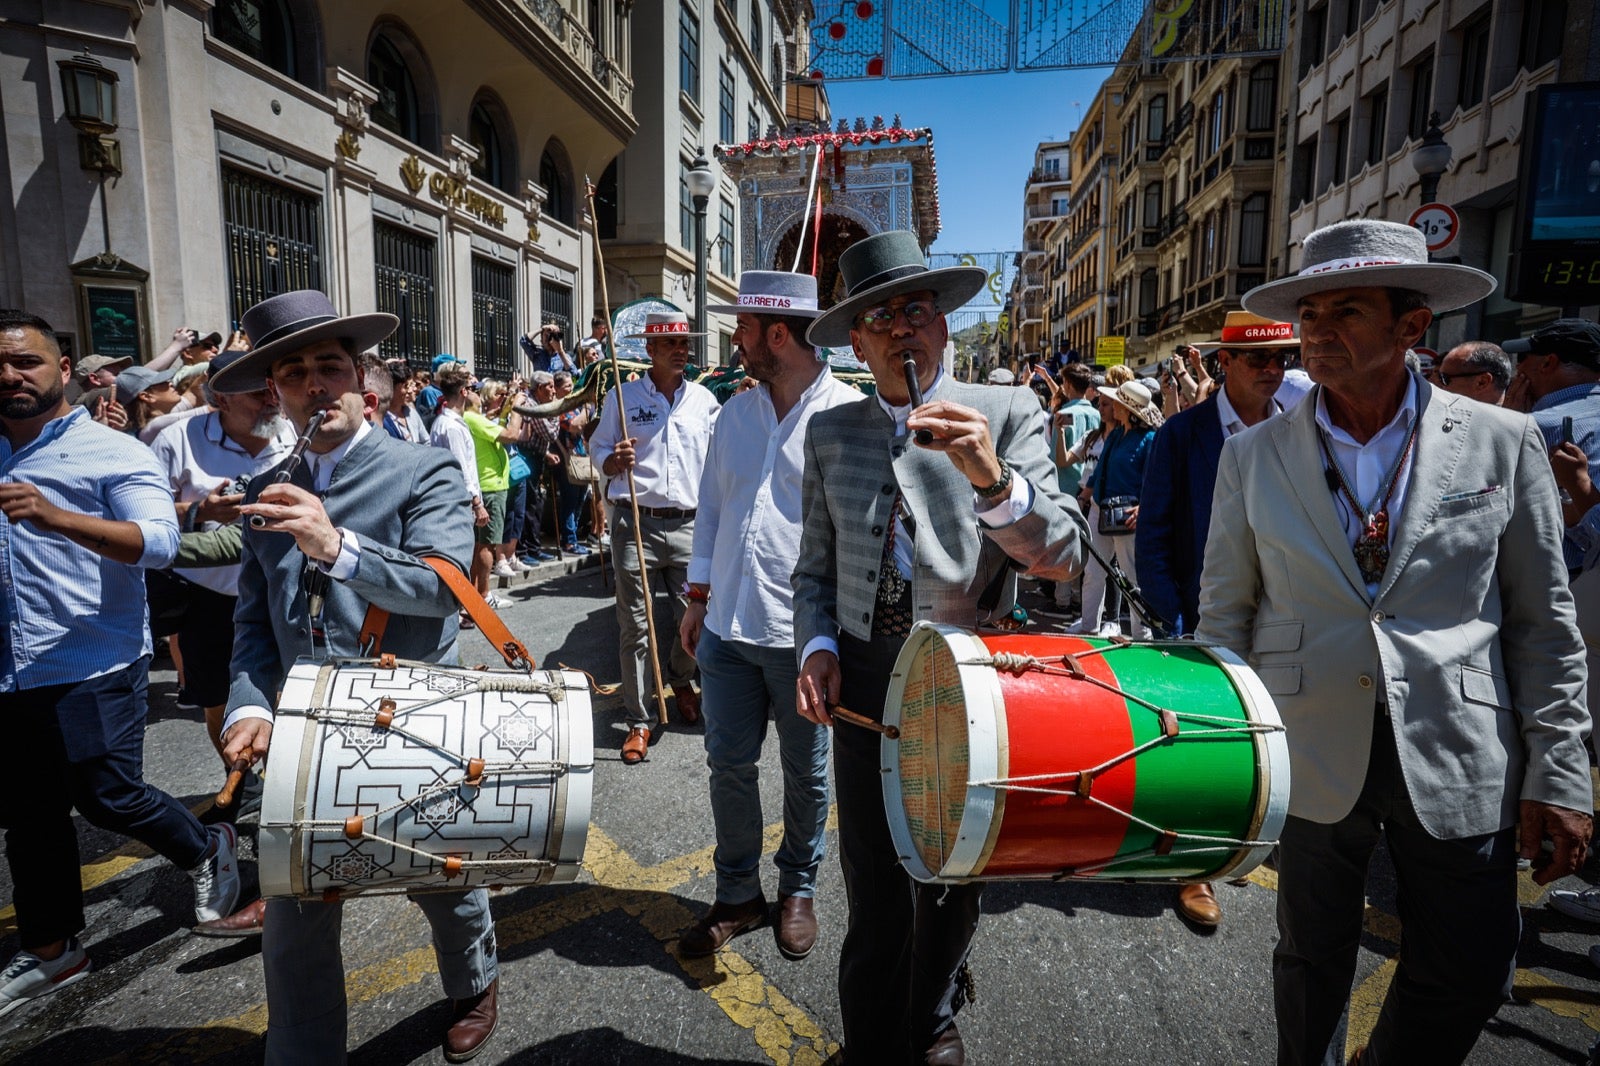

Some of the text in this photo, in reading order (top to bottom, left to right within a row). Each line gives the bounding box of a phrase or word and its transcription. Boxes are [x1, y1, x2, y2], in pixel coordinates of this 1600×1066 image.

[742, 296, 791, 308] CARRETAS
[653, 323, 688, 333] GRAN
[1245, 327, 1290, 337] GRANADA
